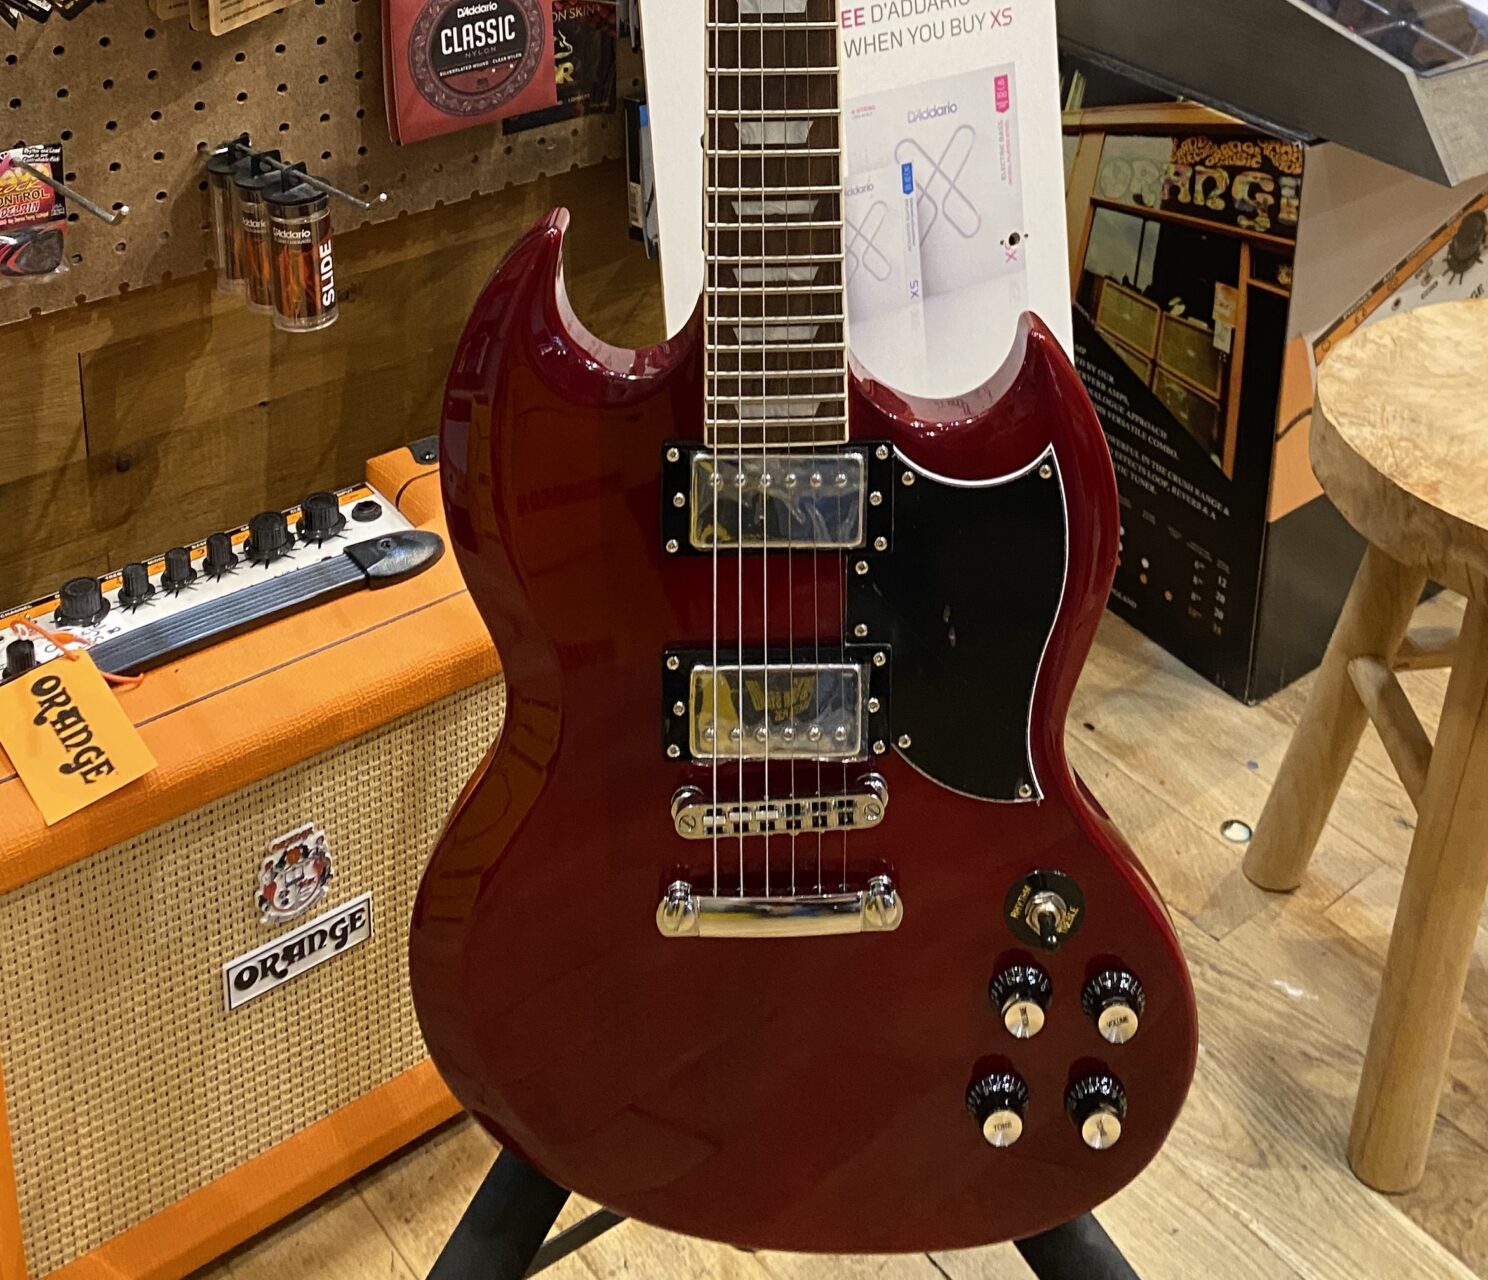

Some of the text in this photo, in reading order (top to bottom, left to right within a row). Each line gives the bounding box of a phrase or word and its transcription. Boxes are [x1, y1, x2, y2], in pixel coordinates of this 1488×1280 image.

[457, 1, 498, 18] D'Addario
[568, 4, 595, 20] SKIN
[440, 14, 516, 55] CLASSIC
[843, 7, 1014, 59] WHEN YOU BUY XS
[464, 46, 498, 59] NYLON
[439, 64, 472, 77] SILVERPLATED
[473, 60, 489, 69] WOUND
[907, 101, 958, 124] D'Addario
[1, 200, 40, 218] DELRIN
[319, 239, 335, 307] SLIDE
[910, 280, 919, 300] XS
[1194, 485, 1223, 511] RANGE
[31, 674, 117, 785] ORANGE
[233, 907, 366, 992] ORANGE
